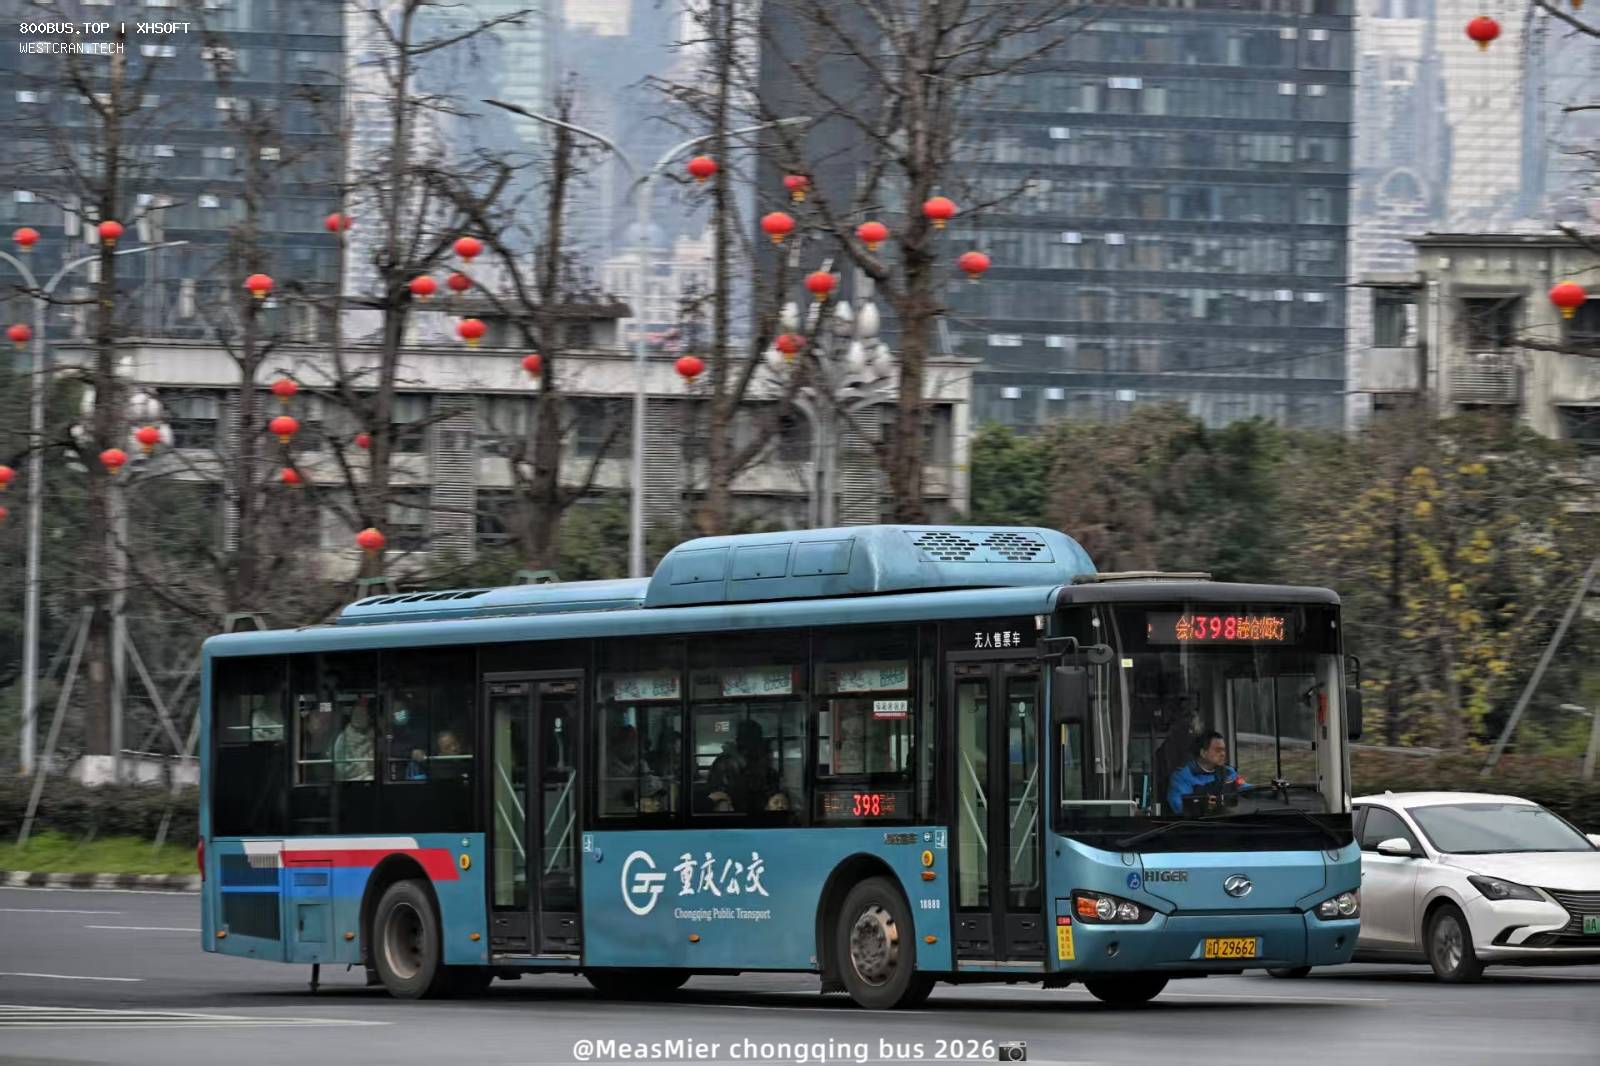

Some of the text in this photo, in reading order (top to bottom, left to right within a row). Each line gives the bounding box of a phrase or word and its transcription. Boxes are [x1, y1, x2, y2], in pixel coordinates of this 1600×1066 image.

[1194, 616, 1237, 639] 398
[974, 631, 1021, 648] 无人售票车
[852, 794, 880, 817] 398
[673, 851, 770, 897] 重庆公交
[1144, 870, 1188, 882] HIGER
[674, 907, 771, 922] Chongqing Public Transport
